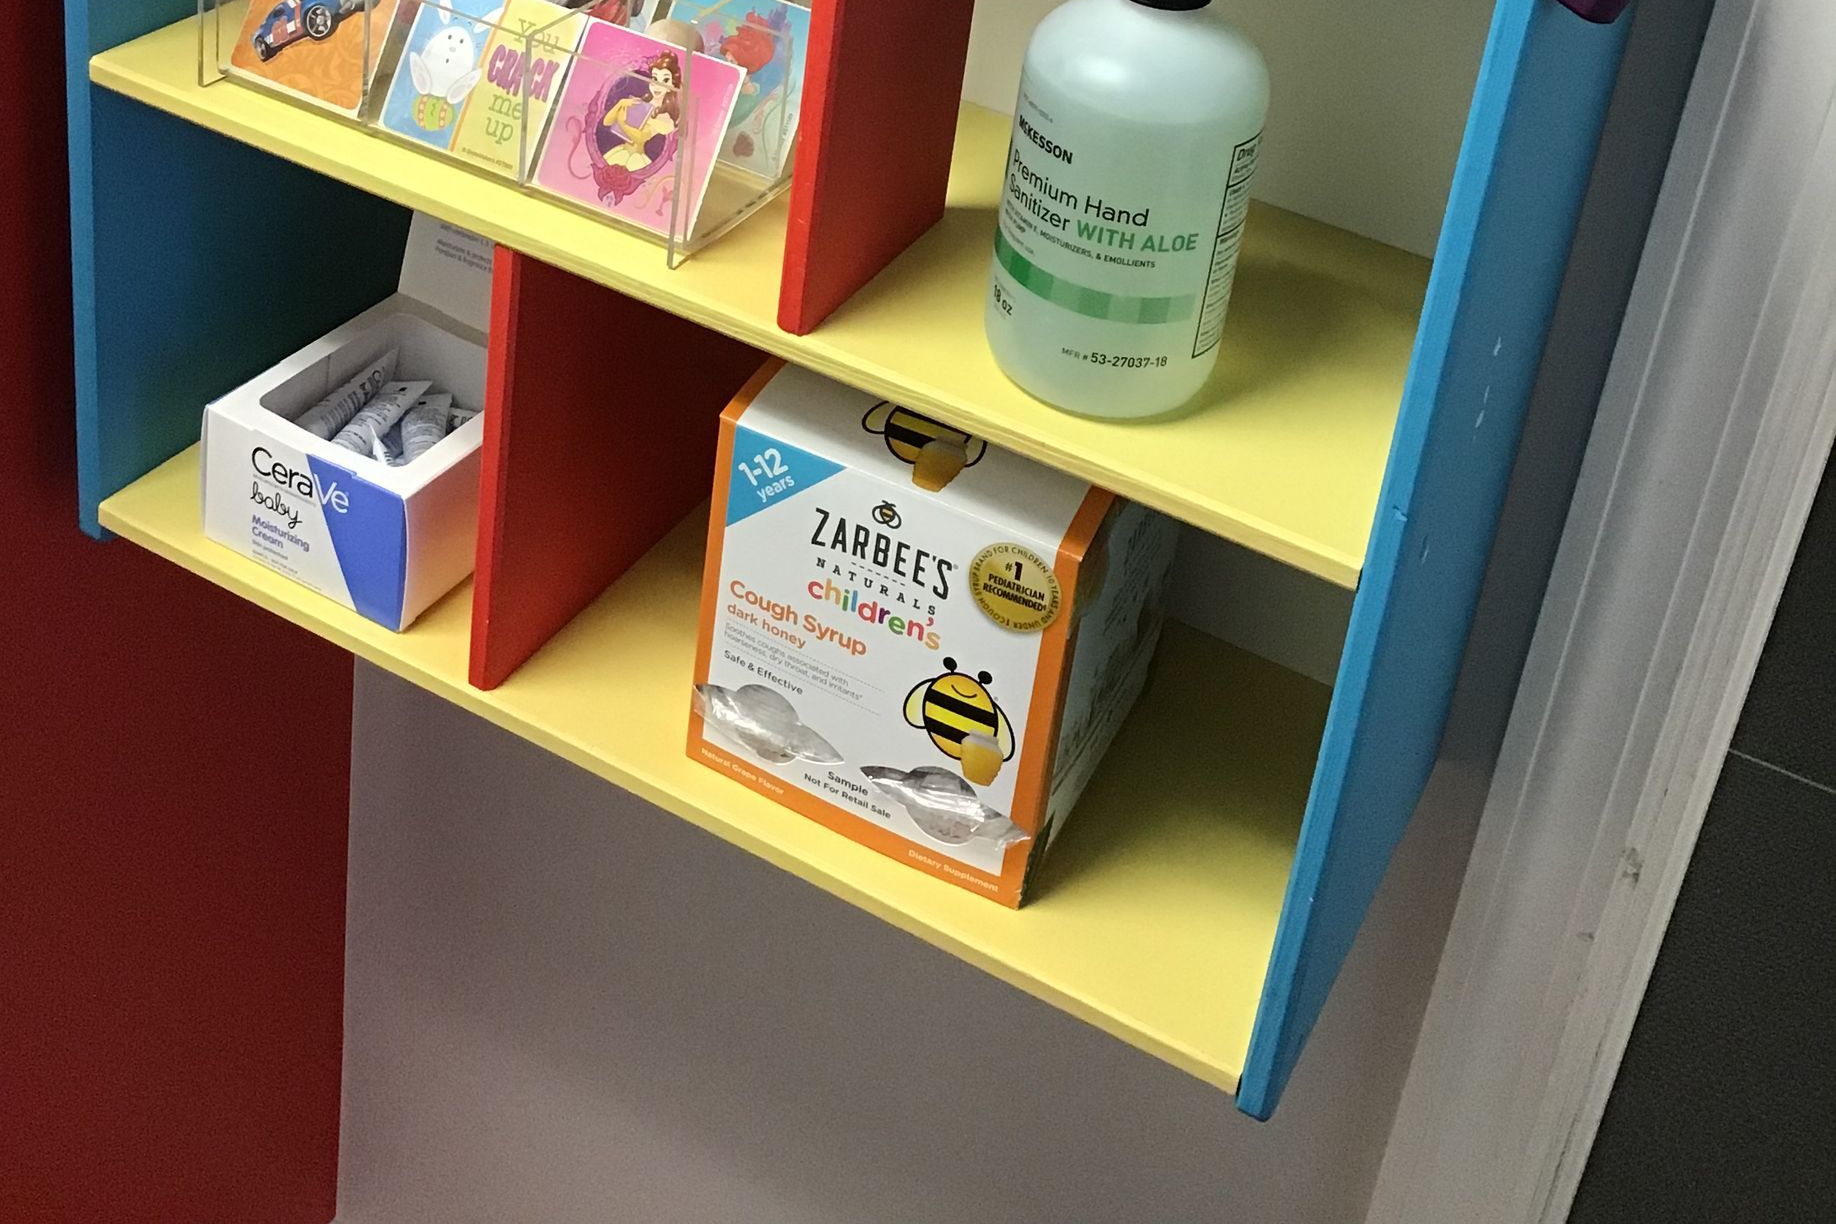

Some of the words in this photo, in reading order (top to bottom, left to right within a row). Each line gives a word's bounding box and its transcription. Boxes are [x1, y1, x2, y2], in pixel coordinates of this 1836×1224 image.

[513, 18, 560, 54] You
[487, 44, 560, 103] CRACK
[488, 94, 522, 120] me
[485, 117, 514, 145] up
[1014, 148, 1078, 210] Premium
[1084, 195, 1150, 226] Hand
[1009, 173, 1070, 231] Sanitizer
[1077, 219, 1135, 250] WITH
[1140, 233, 1199, 252] ALOE
[1104, 255, 1156, 268] EMOLLIENTS
[993, 284, 1001, 303] 18
[1090, 352, 1168, 368] 53-27037-18
[252, 446, 349, 513] CeraVe
[738, 448, 788, 486] 1-12
[756, 475, 795, 503] years
[250, 481, 303, 529] baby
[252, 515, 310, 552] Moisturizing
[252, 526, 283, 549] Cream
[811, 507, 953, 600] ZARBEE'S
[992, 545, 1009, 554] FOR
[1011, 546, 1049, 574] CHILDREN
[816, 557, 936, 615] NATURALS
[988, 573, 1045, 602] PEDIATRICIAN
[727, 603, 758, 626] dark
[761, 618, 806, 650] honey
[730, 580, 799, 625] Cough
[802, 614, 867, 656] Syrup
[807, 578, 941, 650] children's
[724, 650, 746, 668] Safe
[747, 662, 755, 672] &
[756, 666, 804, 695] Effective
[725, 622, 756, 643] Soothes
[757, 639, 786, 659] coughs
[787, 655, 830, 677] associated
[831, 675, 849, 687] with
[769, 653, 782, 665] dry
[811, 671, 827, 686] and
[701, 747, 731, 768] Natural
[731, 764, 757, 782] Grape
[758, 776, 785, 795] Flavor
[827, 771, 869, 796] Sample
[804, 773, 821, 787] Not
[823, 783, 839, 795] For
[841, 791, 868, 809] Retail
[870, 805, 891, 819] Sale
[908, 849, 942, 869] Dietary
[943, 864, 999, 893] Supplement
